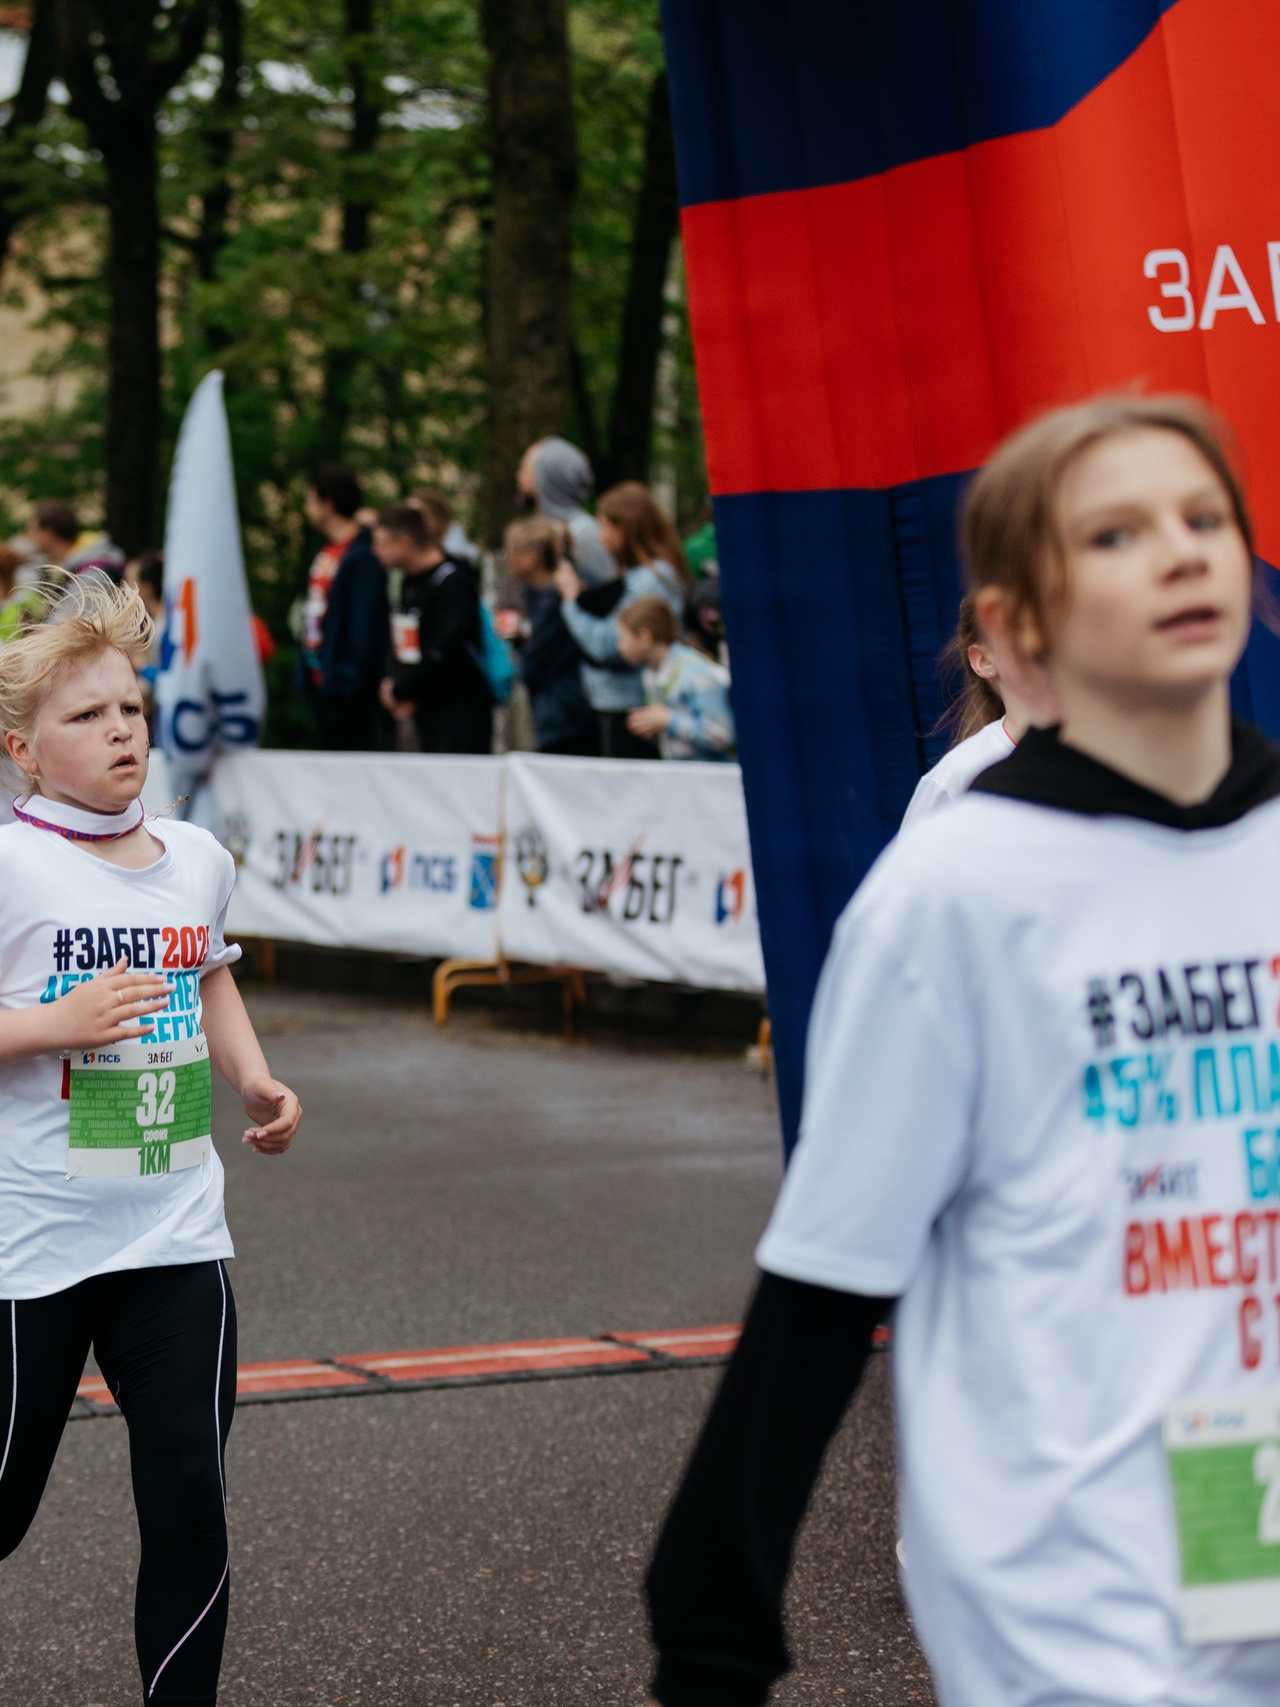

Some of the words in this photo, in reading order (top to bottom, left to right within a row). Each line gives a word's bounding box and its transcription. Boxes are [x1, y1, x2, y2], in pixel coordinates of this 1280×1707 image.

[98, 1054, 121, 1064] ПСБ
[136, 1070, 176, 1127] 32
[1084, 1054, 1176, 1132] 45%
[143, 1128, 168, 1143] СОФИЯ
[138, 1144, 171, 1176] 1КМ
